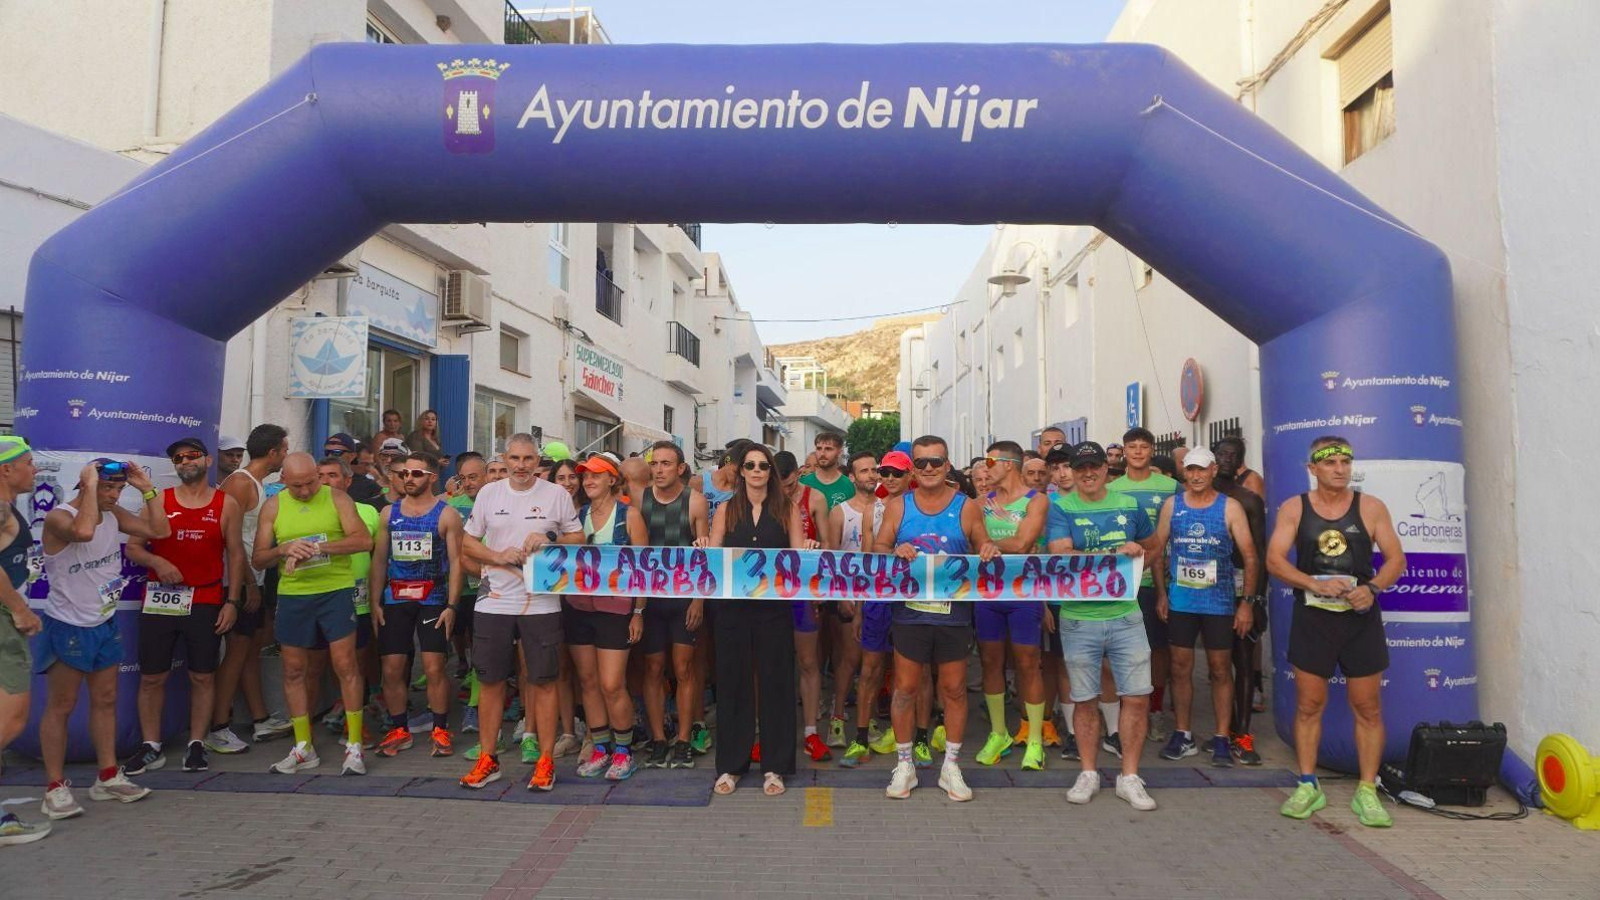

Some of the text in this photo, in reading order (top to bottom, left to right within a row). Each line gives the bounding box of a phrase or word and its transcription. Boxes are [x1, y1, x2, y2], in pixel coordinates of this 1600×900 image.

[516, 81, 1038, 143] Ayuntamiento de Níjar
[366, 276, 400, 300] barquita
[577, 344, 624, 379] SUPERMERCADO
[24, 368, 131, 383] Ayuntamiento de Níjar
[582, 367, 615, 397] Sánchez
[1342, 375, 1450, 390] Ayuntamiento de Níjar
[87, 408, 202, 428] Ayuntamiento de Níjar
[1327, 416, 1341, 426] de
[1342, 414, 1378, 427] Níjar
[1397, 521, 1462, 538] Carboneras
[397, 540, 422, 551] 113
[616, 546, 709, 572] AGUA
[817, 551, 912, 577] AGUA
[1022, 555, 1119, 579] AGUA
[608, 563, 717, 596] CARBO
[1181, 567, 1206, 579] 169
[1452, 566, 1463, 578] de
[808, 570, 920, 599] CARBO
[1011, 570, 1127, 598] CARBO
[152, 592, 181, 605] 506
[1432, 636, 1444, 647] de
[1444, 636, 1466, 649] Níjar
